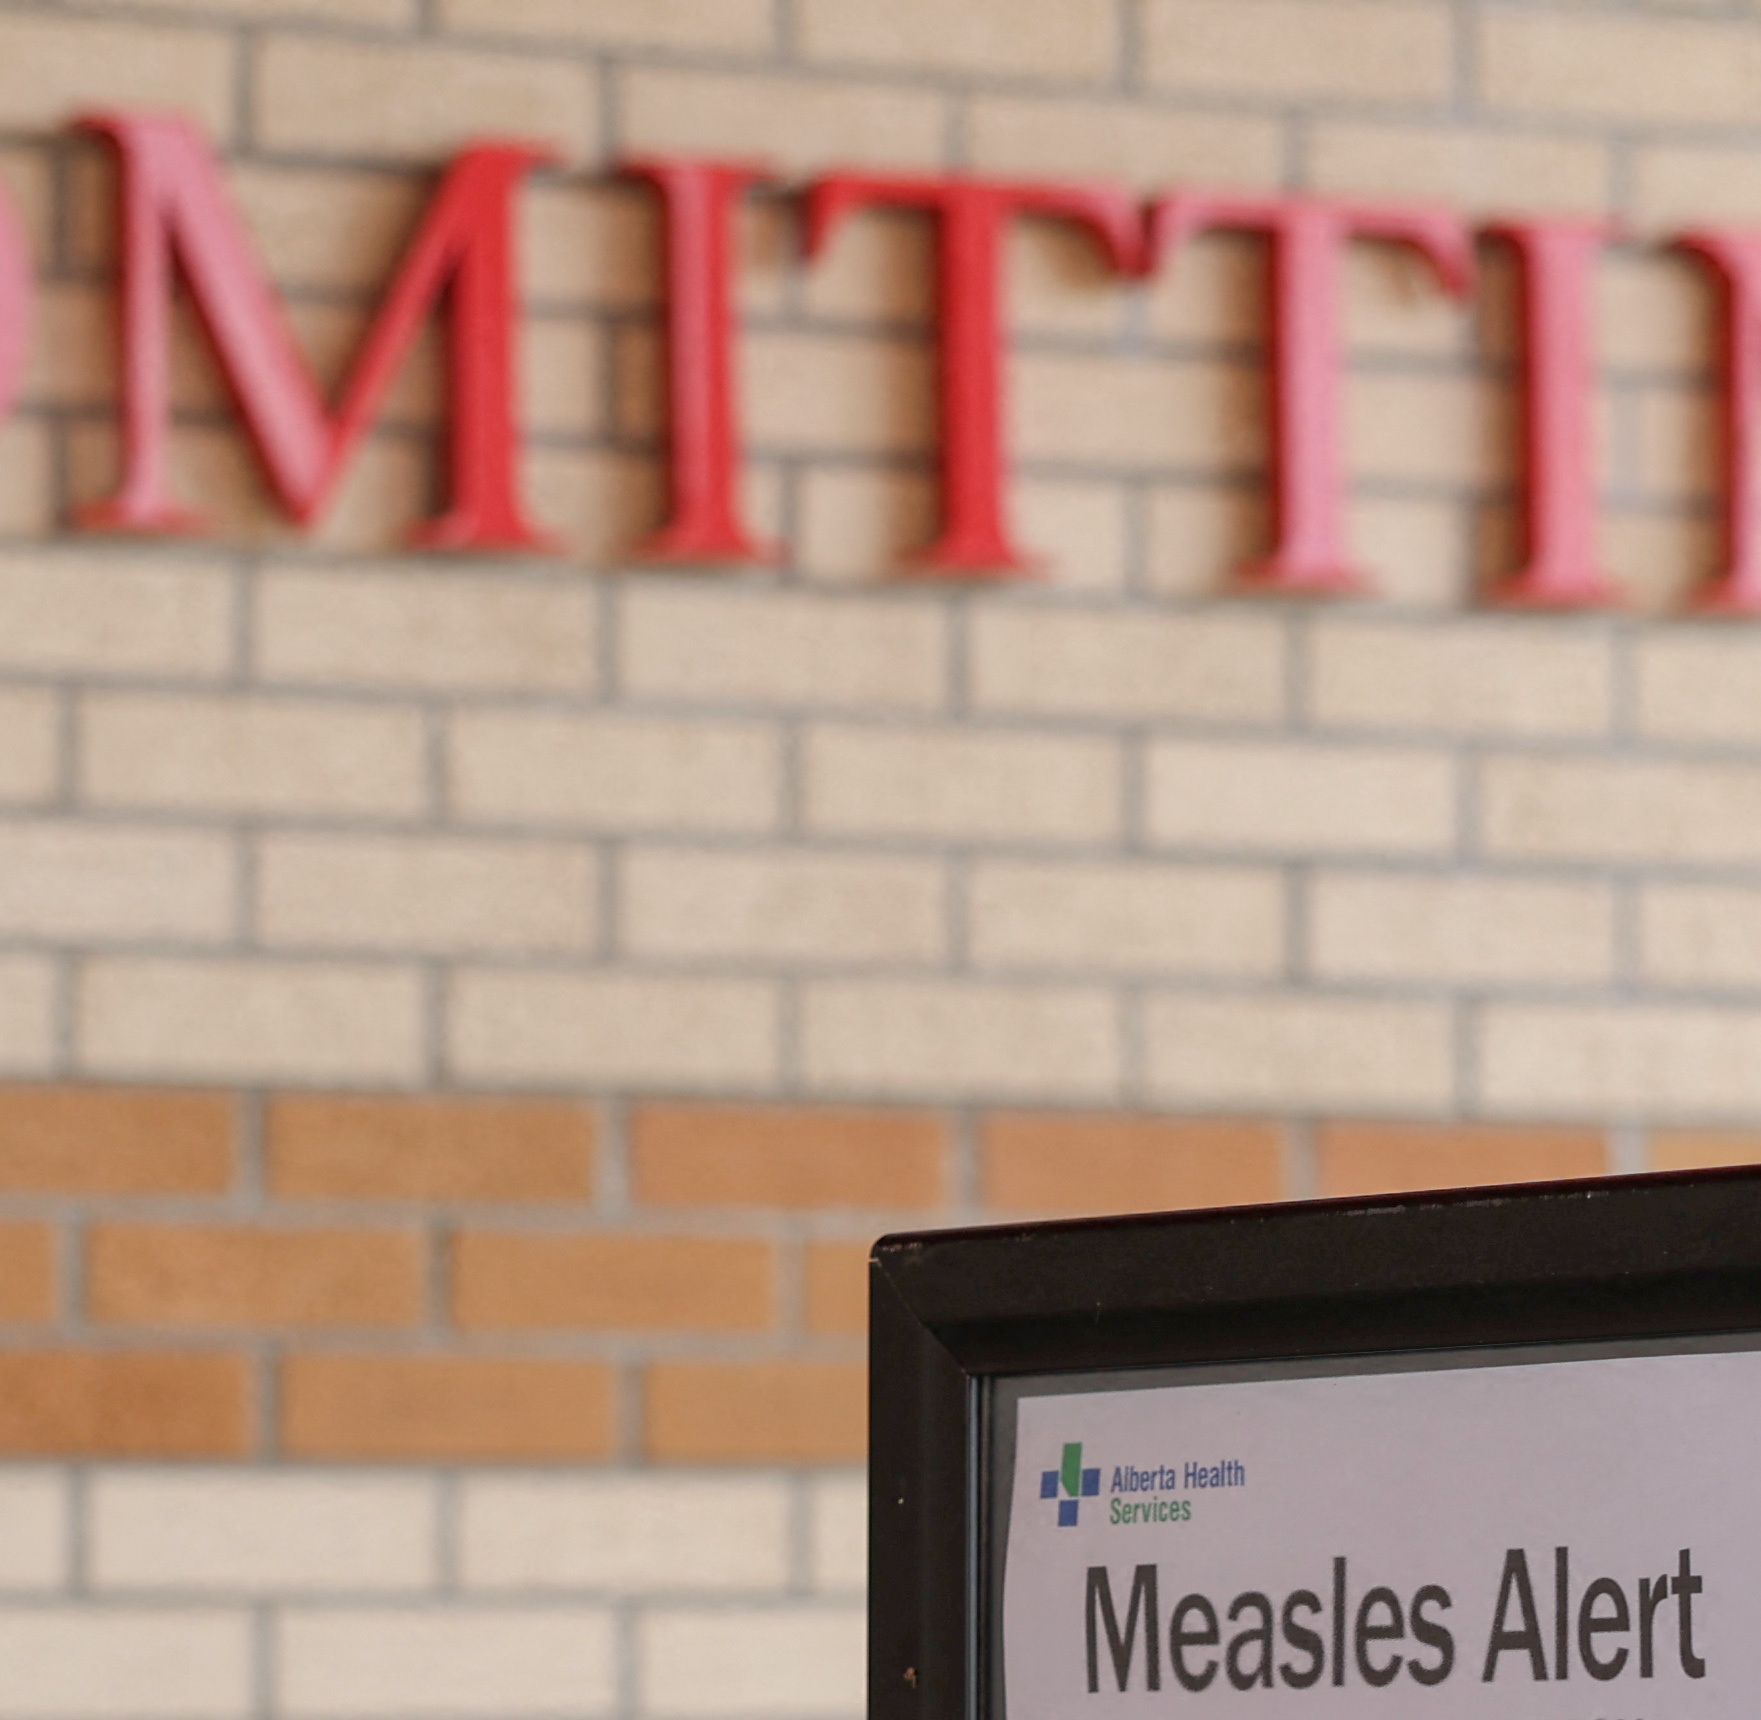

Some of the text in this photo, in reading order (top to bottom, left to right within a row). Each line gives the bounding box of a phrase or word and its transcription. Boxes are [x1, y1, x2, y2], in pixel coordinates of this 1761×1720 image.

[1110, 1460, 1245, 1493] Alberta Health
[1110, 1497, 1191, 1525] Services
[1085, 1547, 1705, 1693] Measles Alert
